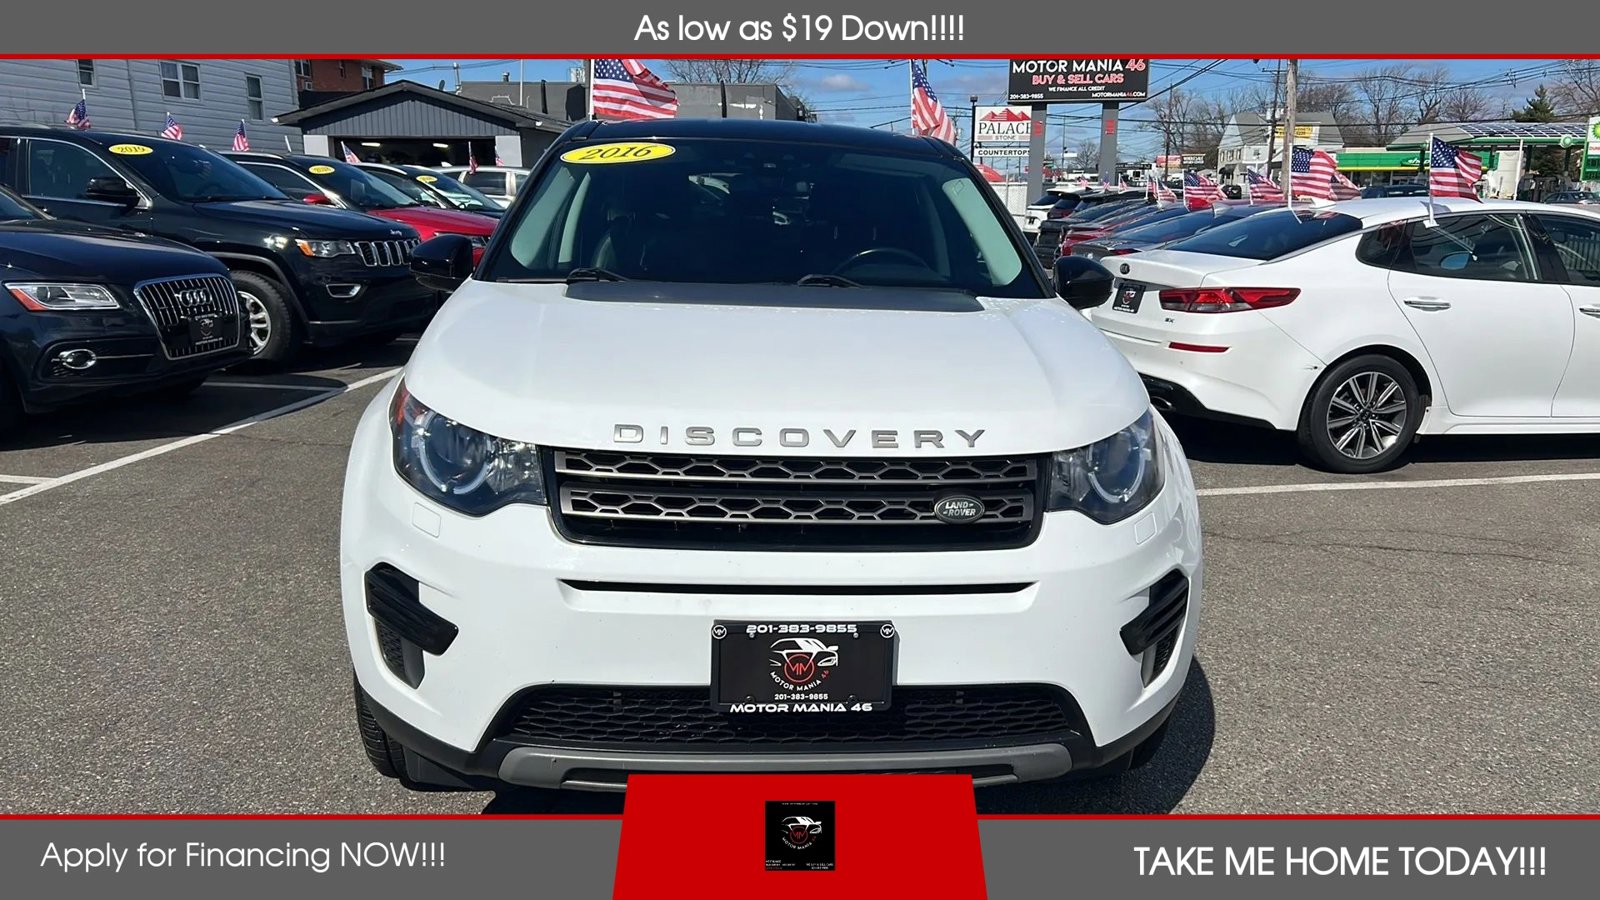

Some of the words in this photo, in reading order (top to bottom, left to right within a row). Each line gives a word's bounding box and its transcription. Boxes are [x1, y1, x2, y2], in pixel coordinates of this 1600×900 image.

[1012, 60, 1067, 73] MOTOR
[1072, 59, 1124, 72] MANIA
[1125, 59, 1146, 71] 46
[1032, 74, 1055, 85] BUY
[1056, 74, 1066, 85] &
[1067, 74, 1093, 85] SELL
[1094, 73, 1125, 84] CARS
[578, 145, 658, 161] 2016
[613, 423, 986, 449] DISCOVERY
[945, 501, 969, 509] LAND
[948, 508, 976, 517] ROVER
[746, 624, 858, 634] 201-383-9855
[770, 671, 794, 691] MOTOR
[797, 679, 822, 692] MANIA
[730, 703, 789, 713] MOTOR
[793, 702, 847, 713] MANIA
[850, 702, 873, 712] 46
